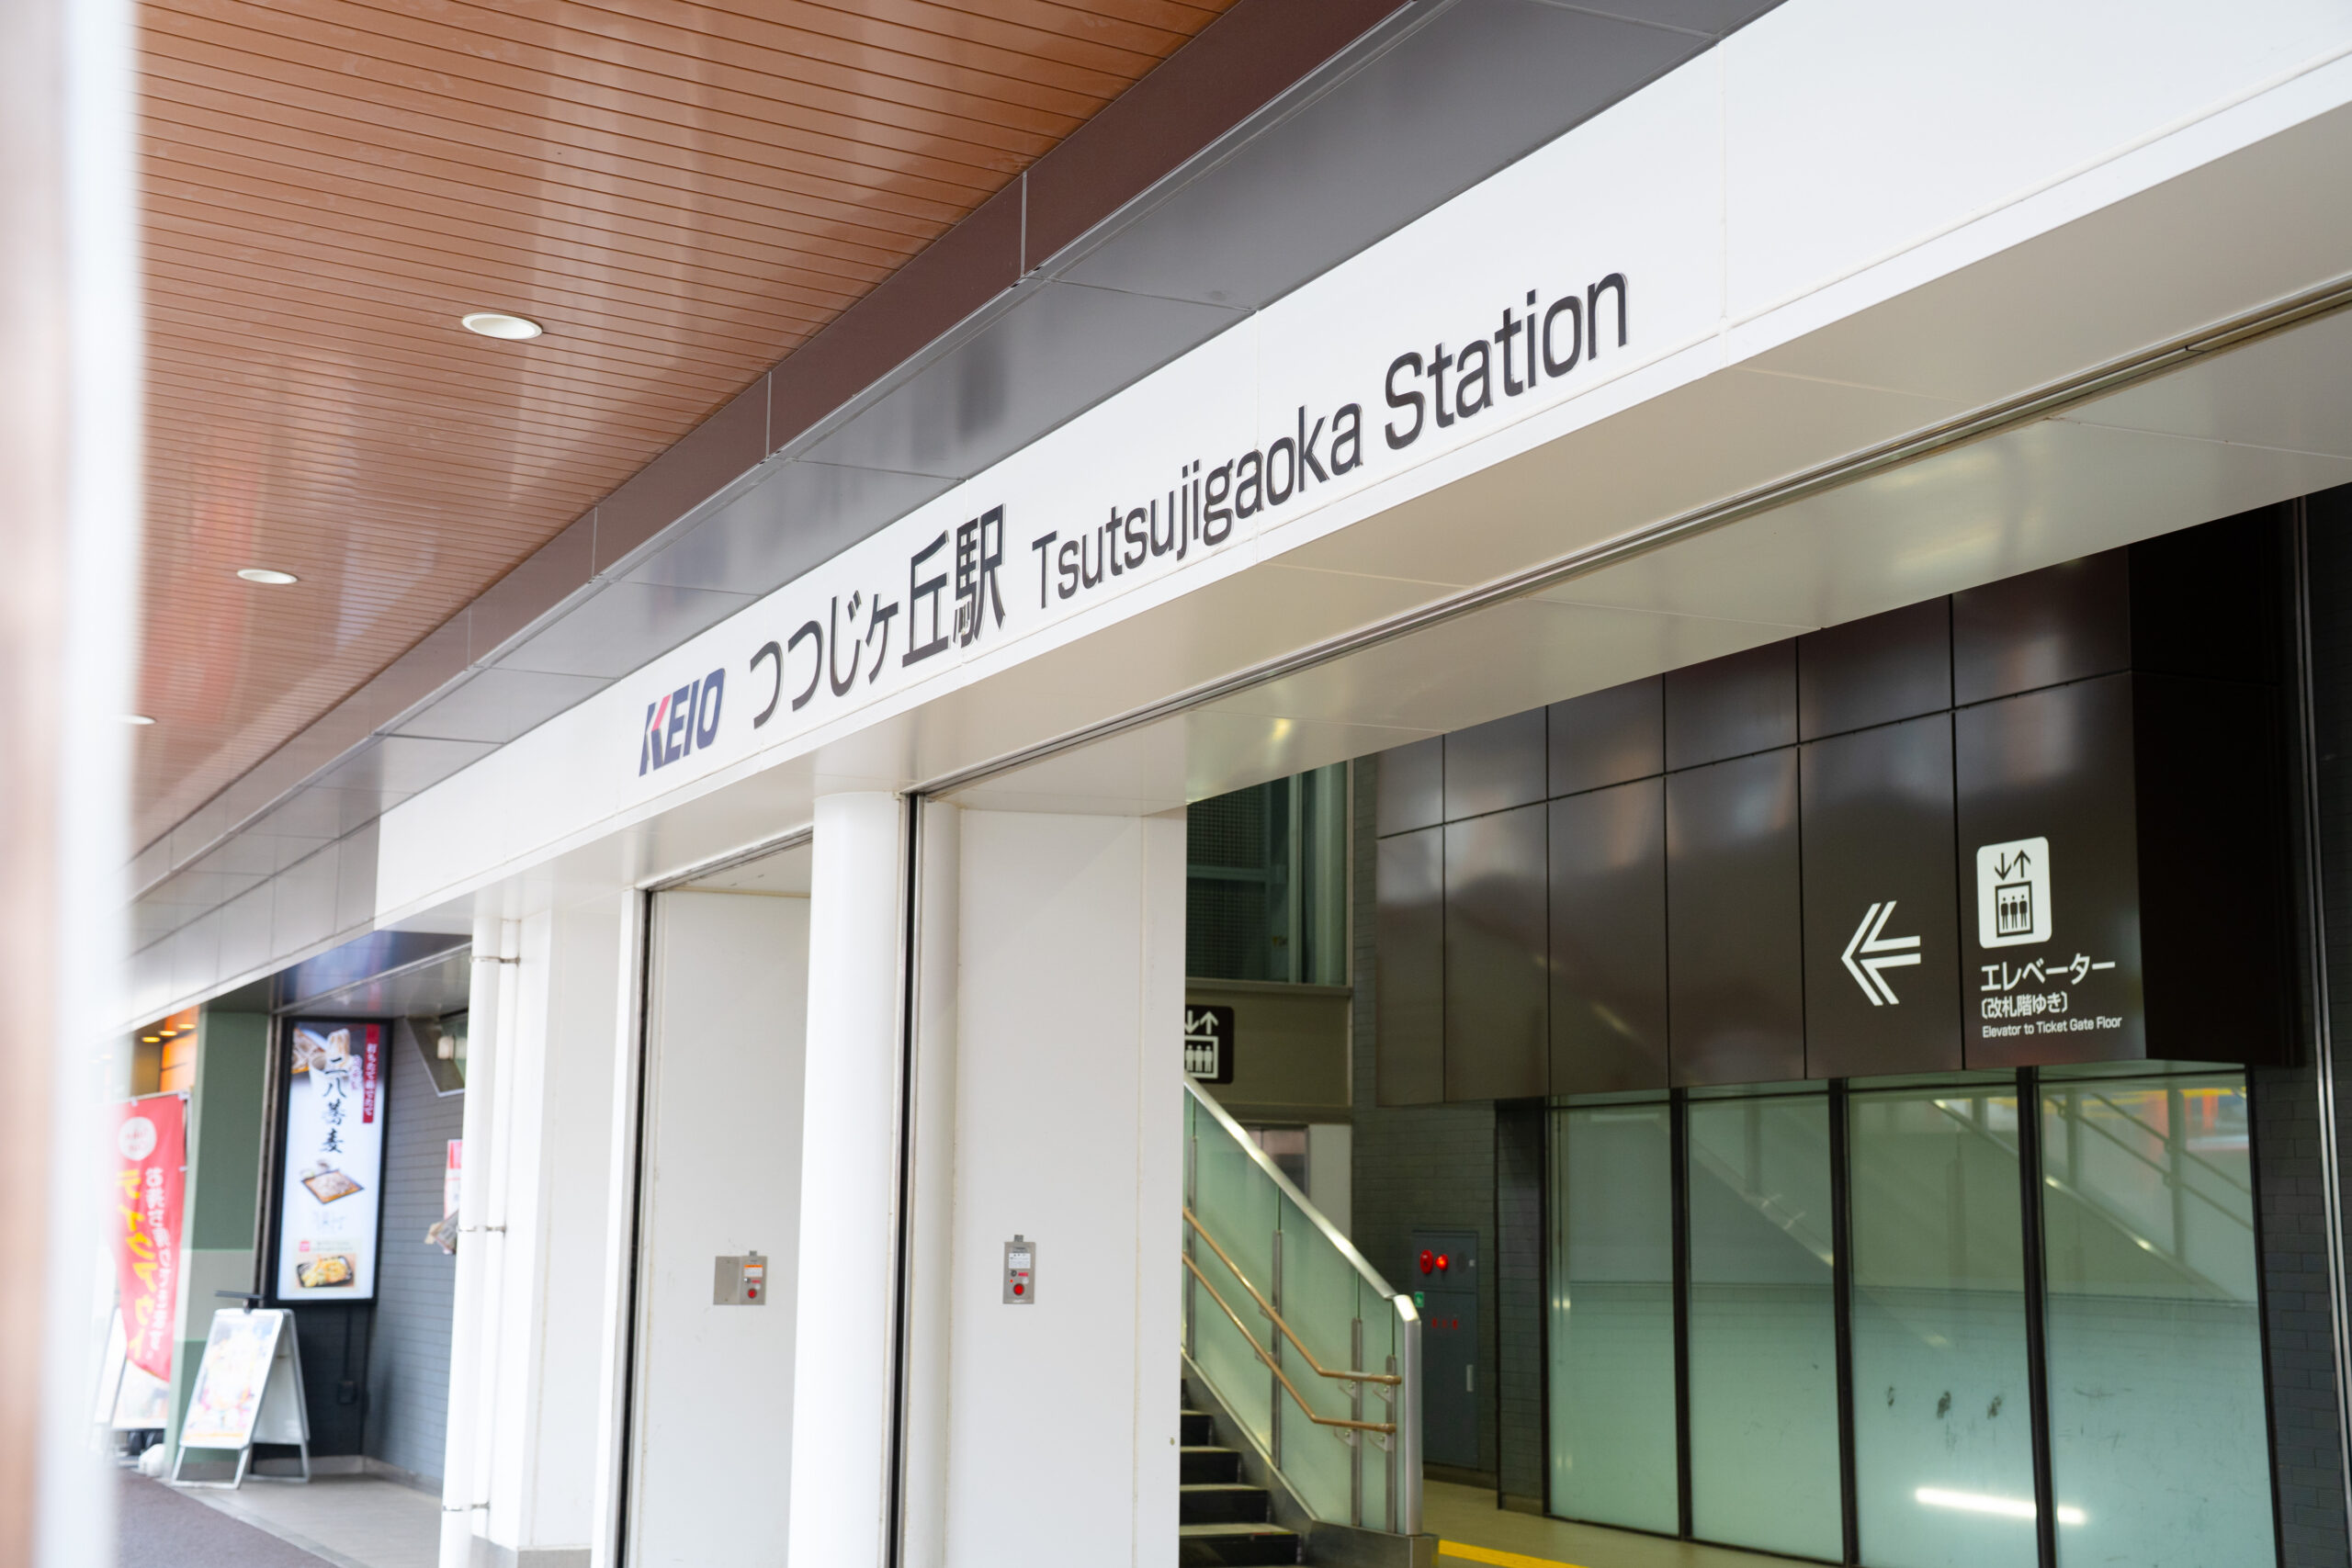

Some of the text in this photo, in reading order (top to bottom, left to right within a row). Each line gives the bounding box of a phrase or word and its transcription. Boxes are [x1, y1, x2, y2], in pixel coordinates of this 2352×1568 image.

[639, 272, 1628, 777] KEIO つつじヶ丘駅 Tsutsujigaoka Station
[1981, 953, 2116, 992] エレベーター
[1982, 1015, 2123, 1038] Elevator to Ticket Gate Floor
